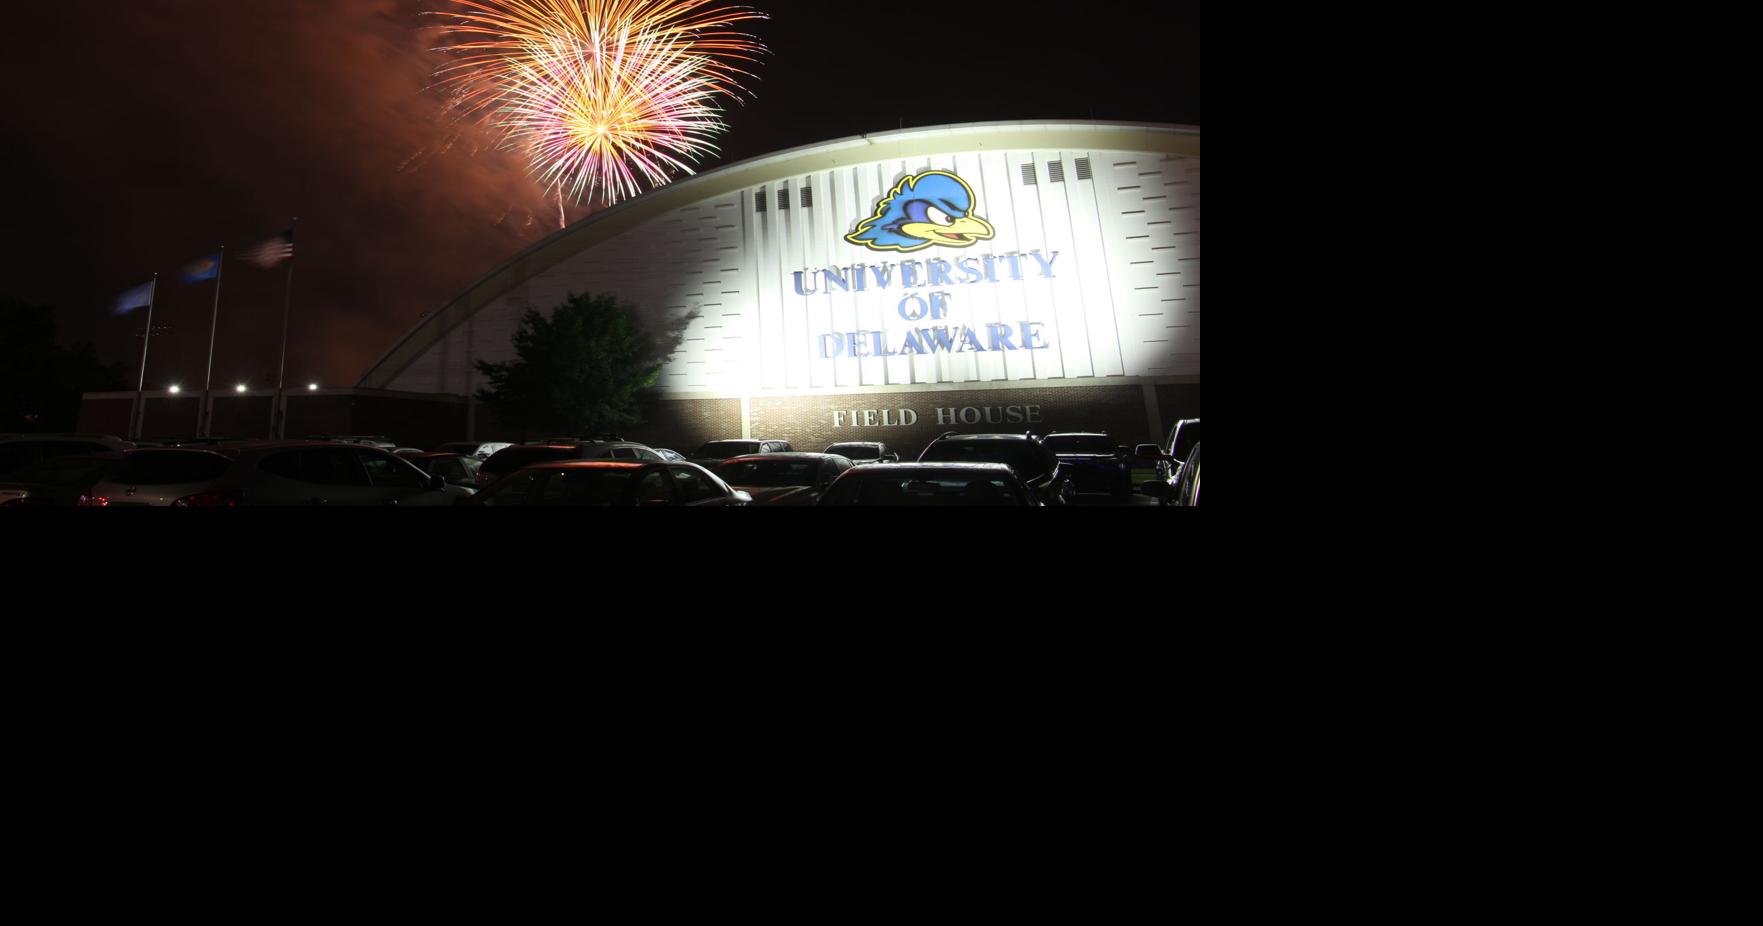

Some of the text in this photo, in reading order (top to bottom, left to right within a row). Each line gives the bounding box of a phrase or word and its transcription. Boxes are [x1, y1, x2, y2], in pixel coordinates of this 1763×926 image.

[792, 250, 1060, 296] UNIVERSITY
[897, 292, 951, 321] OF
[818, 322, 1050, 359] DELAWARE
[832, 404, 1042, 428] FIELD HOUSE
